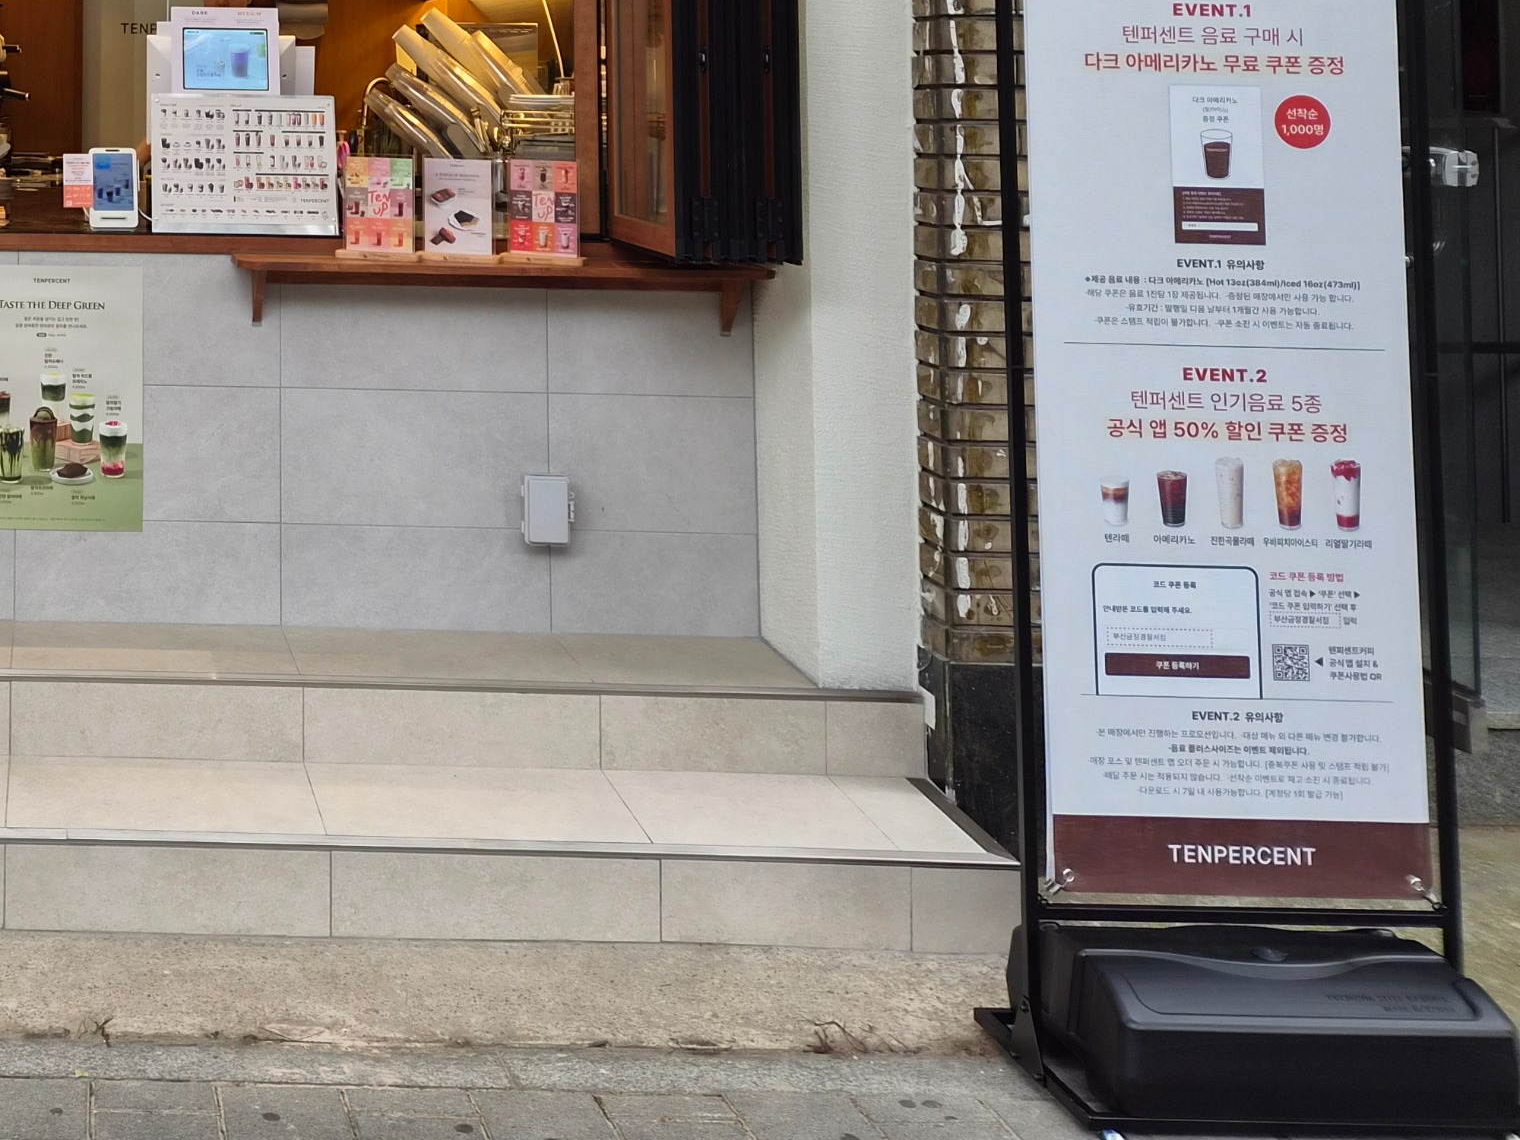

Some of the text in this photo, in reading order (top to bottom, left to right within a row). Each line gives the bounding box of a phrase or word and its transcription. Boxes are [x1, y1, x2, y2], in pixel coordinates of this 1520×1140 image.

[1172, 2, 1250, 17] EVENT.1
[1122, 24, 1302, 46] 텐퍼센트 음료 구매 시
[1084, 51, 1343, 75] 다크 아메리카노 무료 쿠폰 증정
[1286, 107, 1319, 120] 선착순
[1281, 123, 1324, 137] 1,000명
[1176, 258, 1264, 270] EVENT.1 유의사항
[27, 300, 47, 310] THE
[48, 300, 72, 310] DEEP
[73, 300, 106, 310] GREEN
[1182, 366, 1267, 383] EVENT.2
[1131, 389, 1322, 414] 텐퍼센트 인기음료 5종
[1106, 417, 1346, 443] 공식 앱 50% 할인 쿠폰 증정
[1153, 534, 1196, 545] 아메리카노
[1191, 710, 1283, 723] EVENT.2 유의사항
[1167, 844, 1316, 866] TENPERCENT
